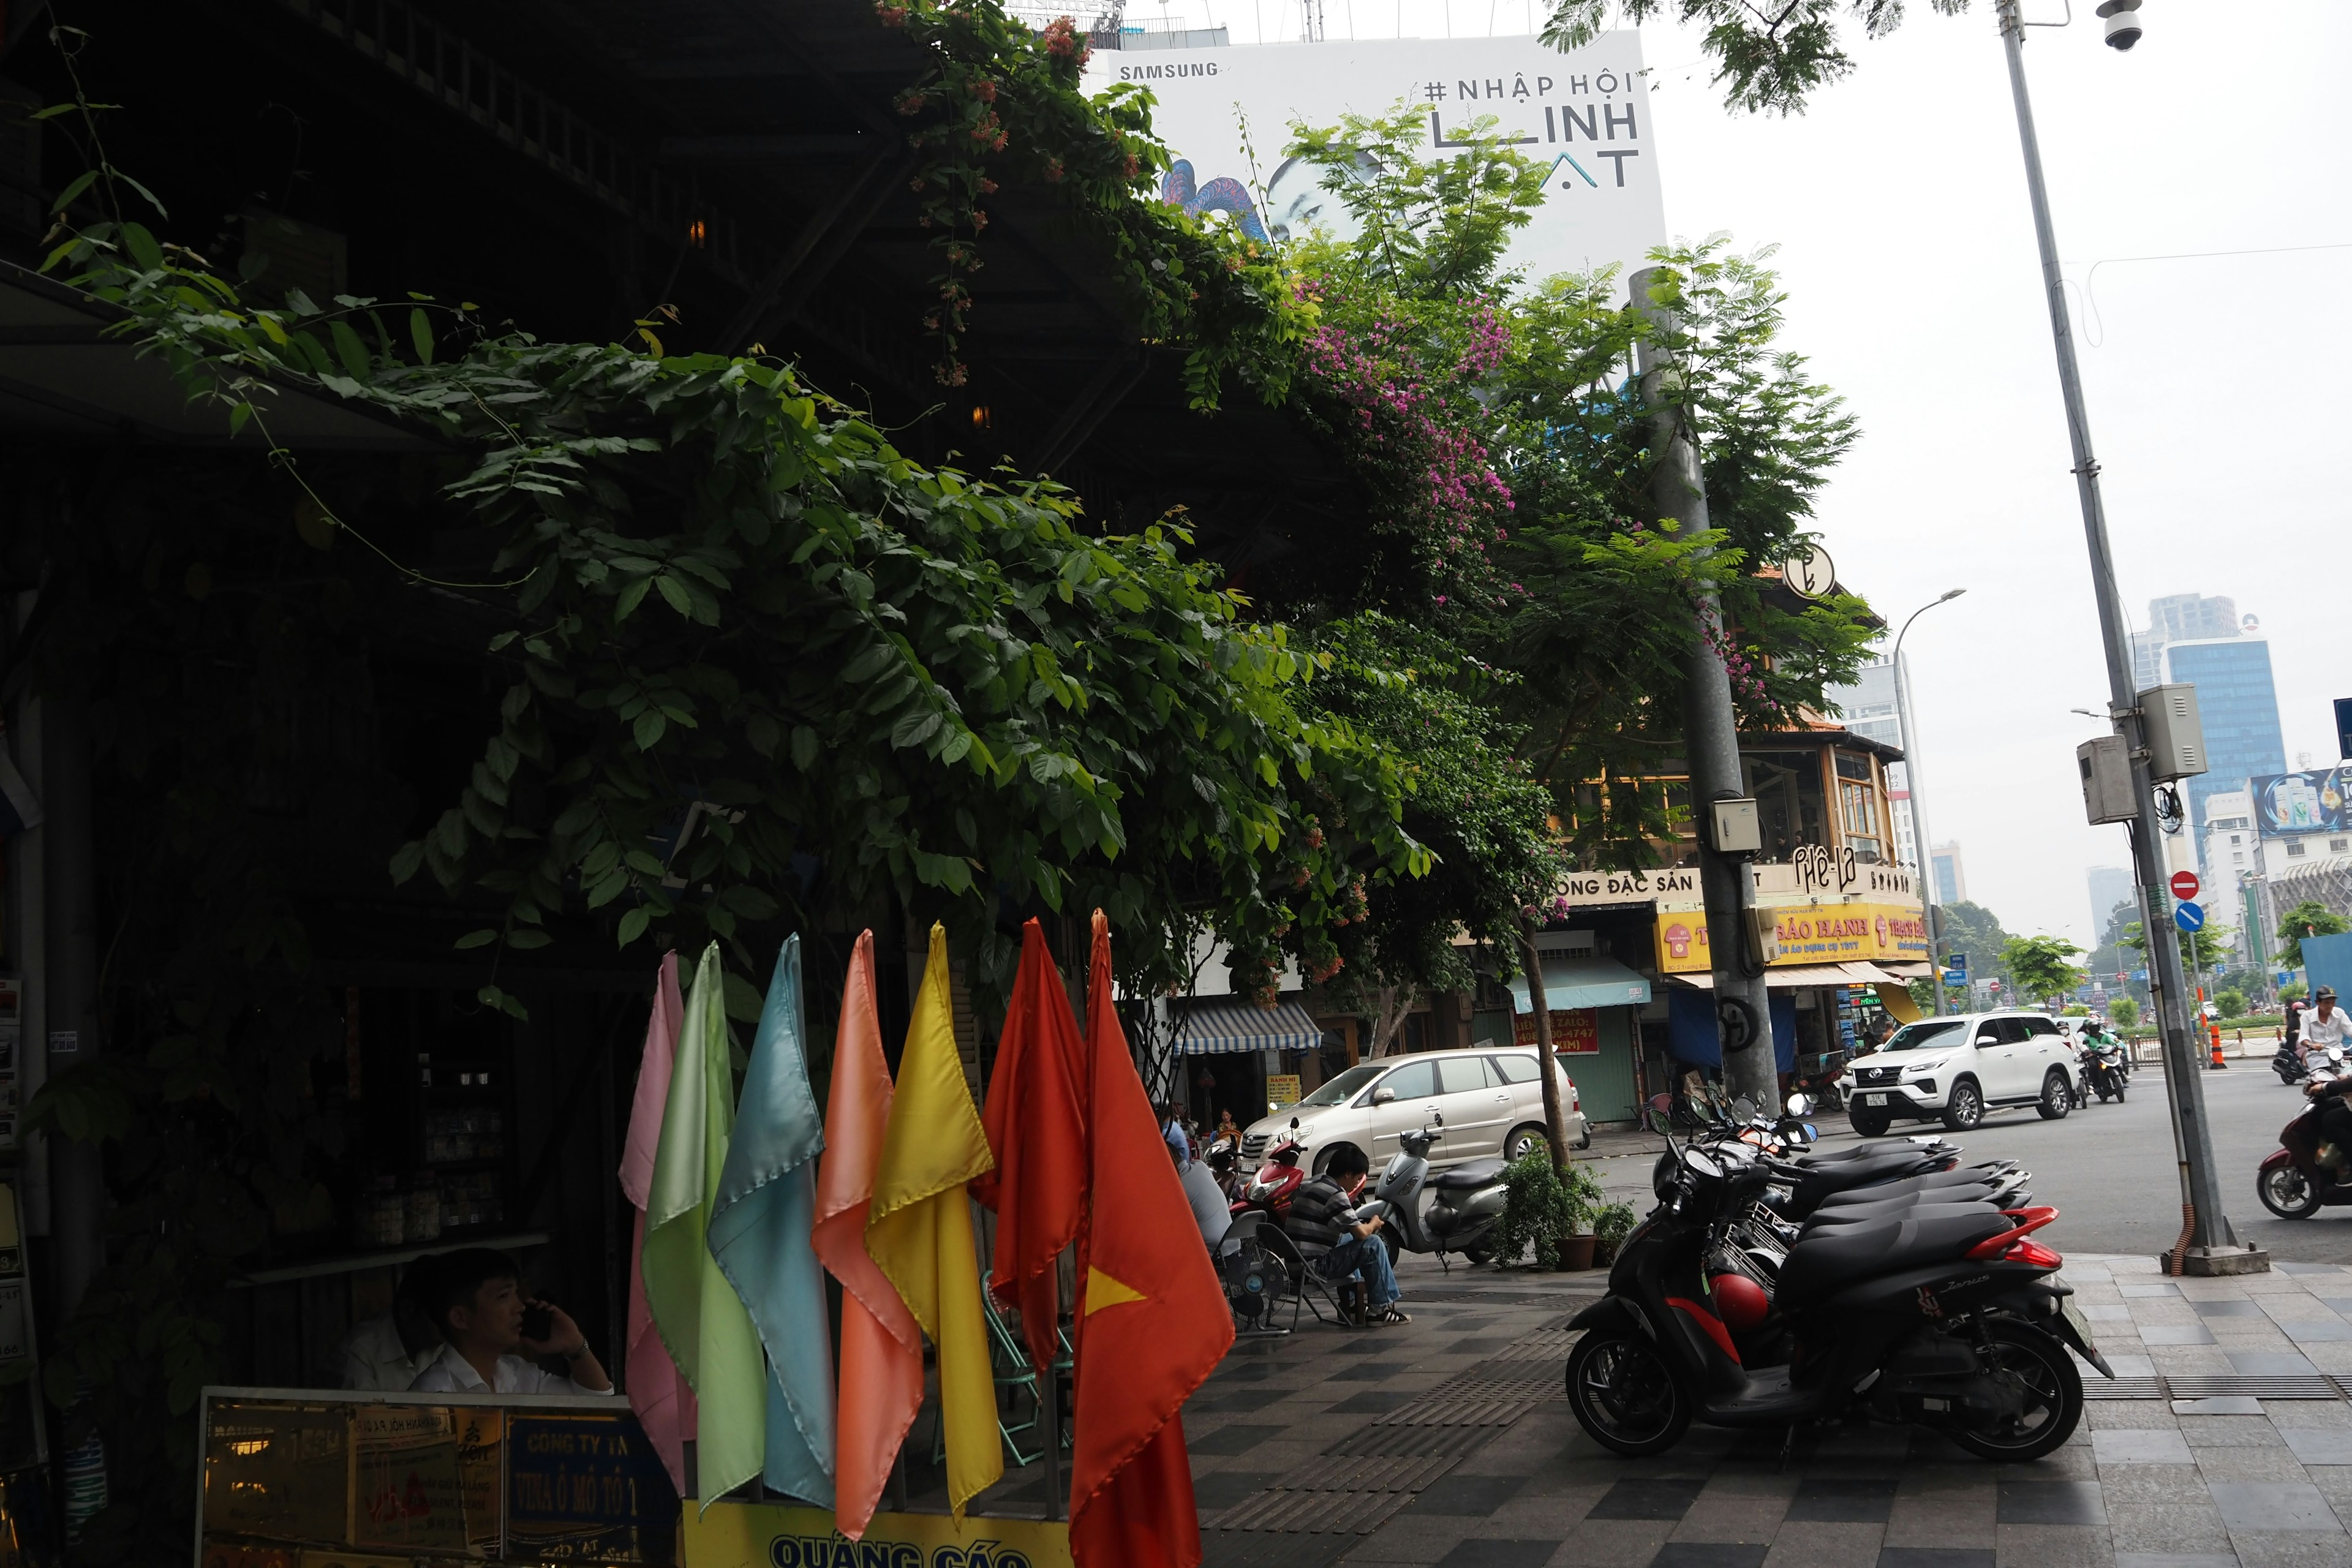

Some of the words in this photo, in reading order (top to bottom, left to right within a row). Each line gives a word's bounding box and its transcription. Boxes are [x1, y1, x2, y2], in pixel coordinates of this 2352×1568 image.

[1120, 62, 1218, 81] SAMSUNG
[1570, 67, 1632, 99] HỘI
[1431, 102, 1638, 148] LINH
[1607, 876, 1648, 897] ĐẶC
[1656, 872, 1692, 892] SẢN
[1777, 916, 1812, 940] BẢO
[1816, 918, 1869, 940] HẠNH
[1557, 1018, 1589, 1027] ZALO:
[1940, 1273, 1991, 1294] Janus
[527, 1428, 575, 1454] CÔNG
[578, 1434, 601, 1455] TY
